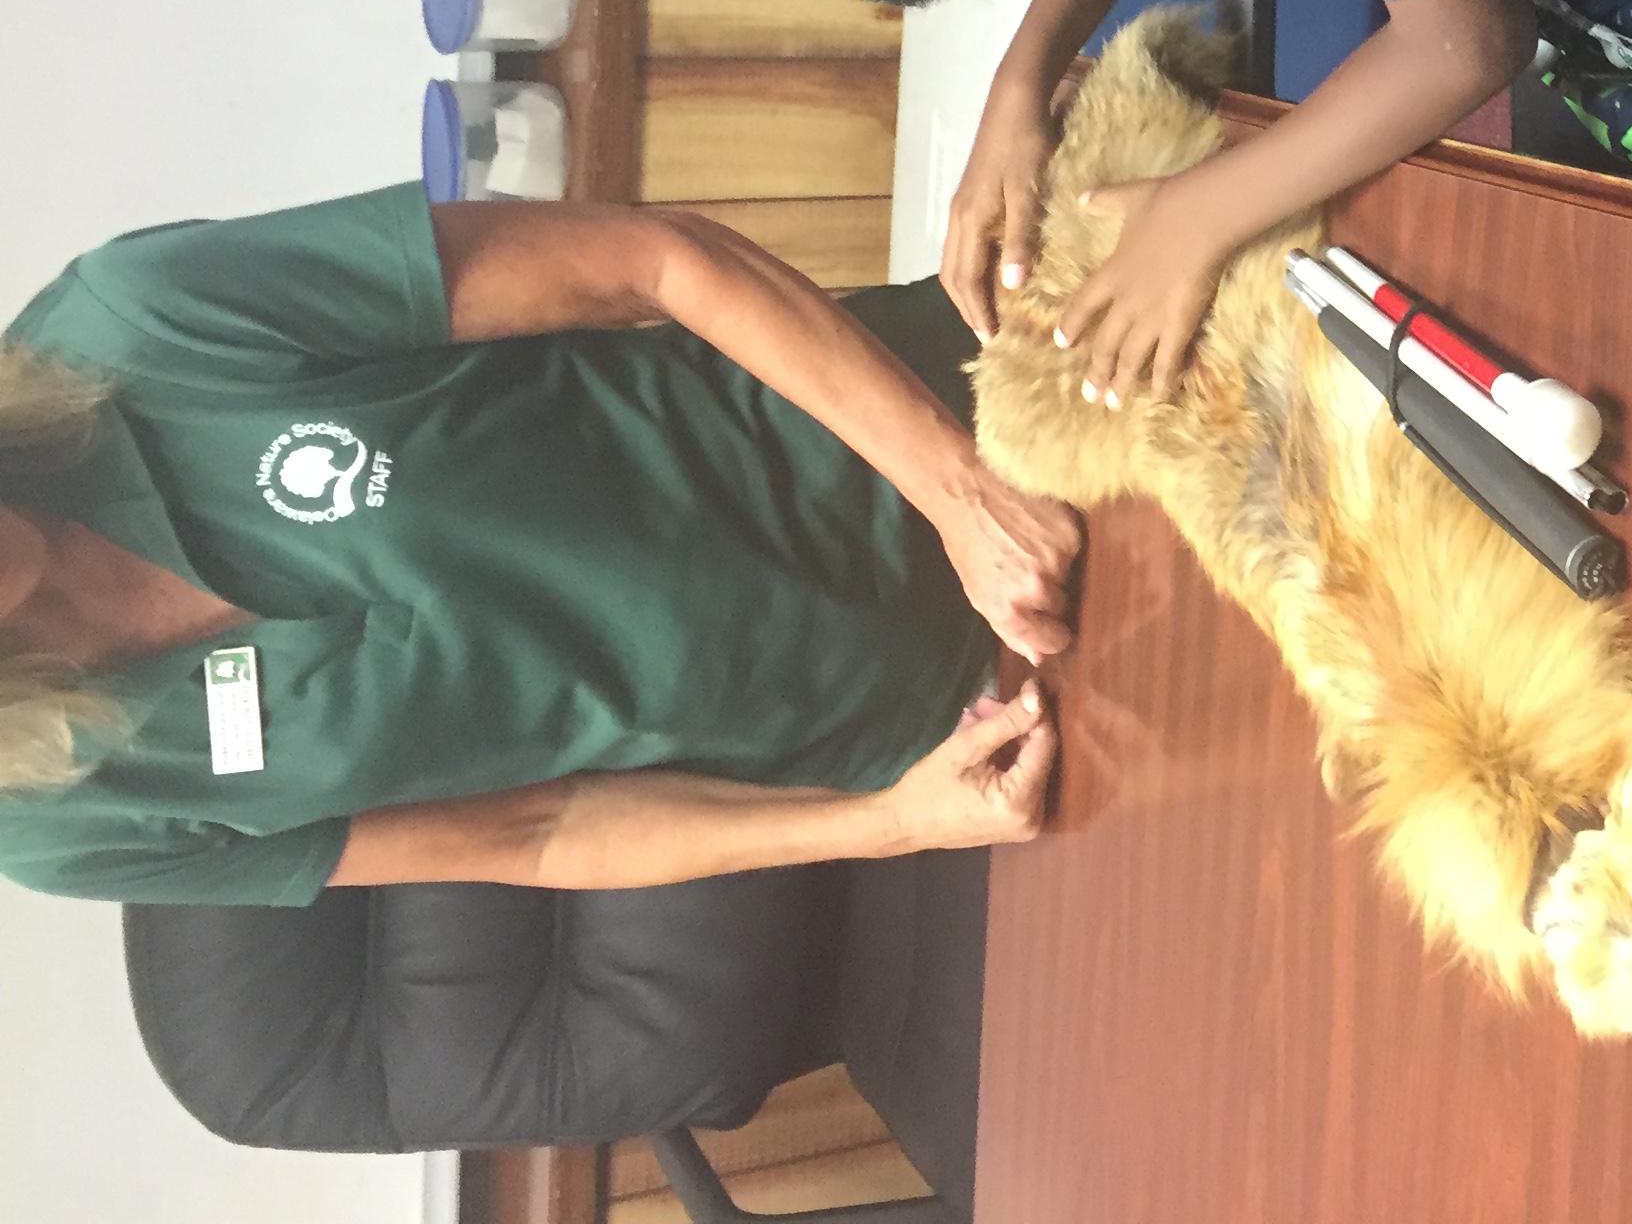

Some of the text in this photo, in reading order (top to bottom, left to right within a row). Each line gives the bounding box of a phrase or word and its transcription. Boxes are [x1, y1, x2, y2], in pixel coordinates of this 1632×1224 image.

[255, 433, 292, 486] Nature
[291, 421, 358, 446] Society
[365, 450, 393, 507] STAFF
